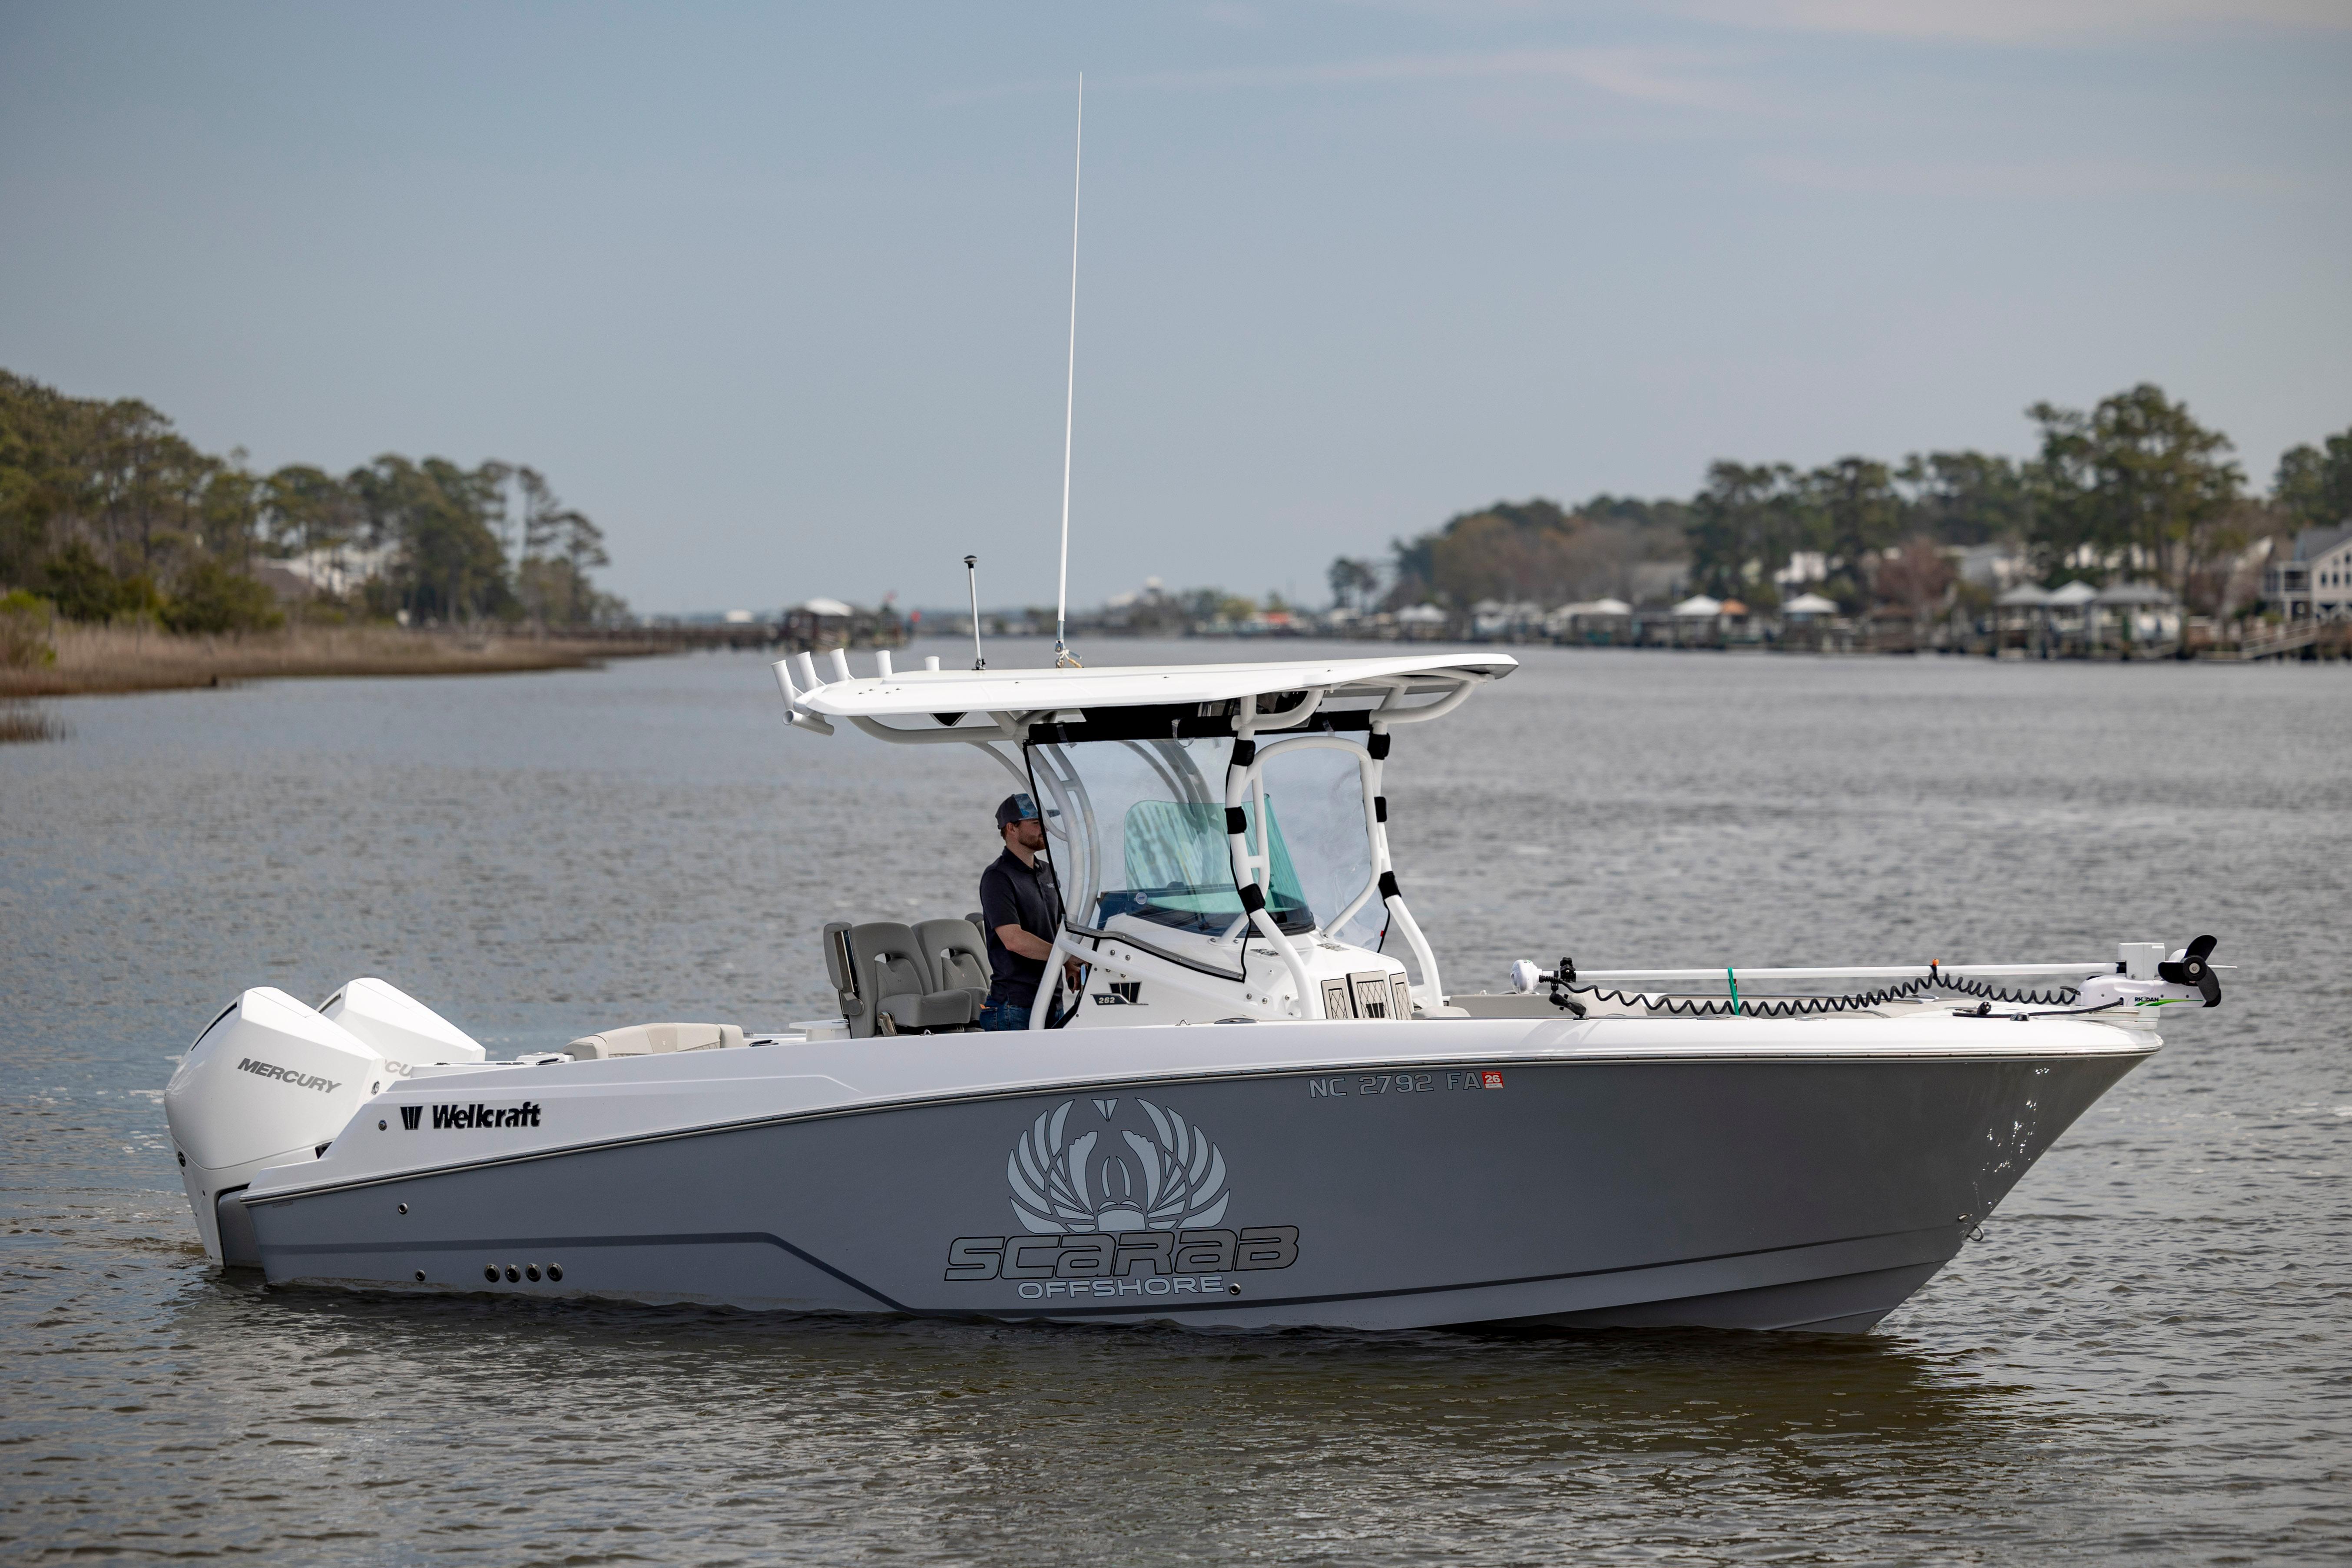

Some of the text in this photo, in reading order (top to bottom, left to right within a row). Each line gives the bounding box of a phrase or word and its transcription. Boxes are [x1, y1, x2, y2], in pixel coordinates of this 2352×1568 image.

[237, 1057, 343, 1093] MERCURY
[1309, 1071, 1482, 1098] NC 2792 FA
[1484, 1074, 1501, 1083] 26
[432, 1101, 541, 1129] Wellcraft
[1017, 1275, 1225, 1299] OFFSHORE
